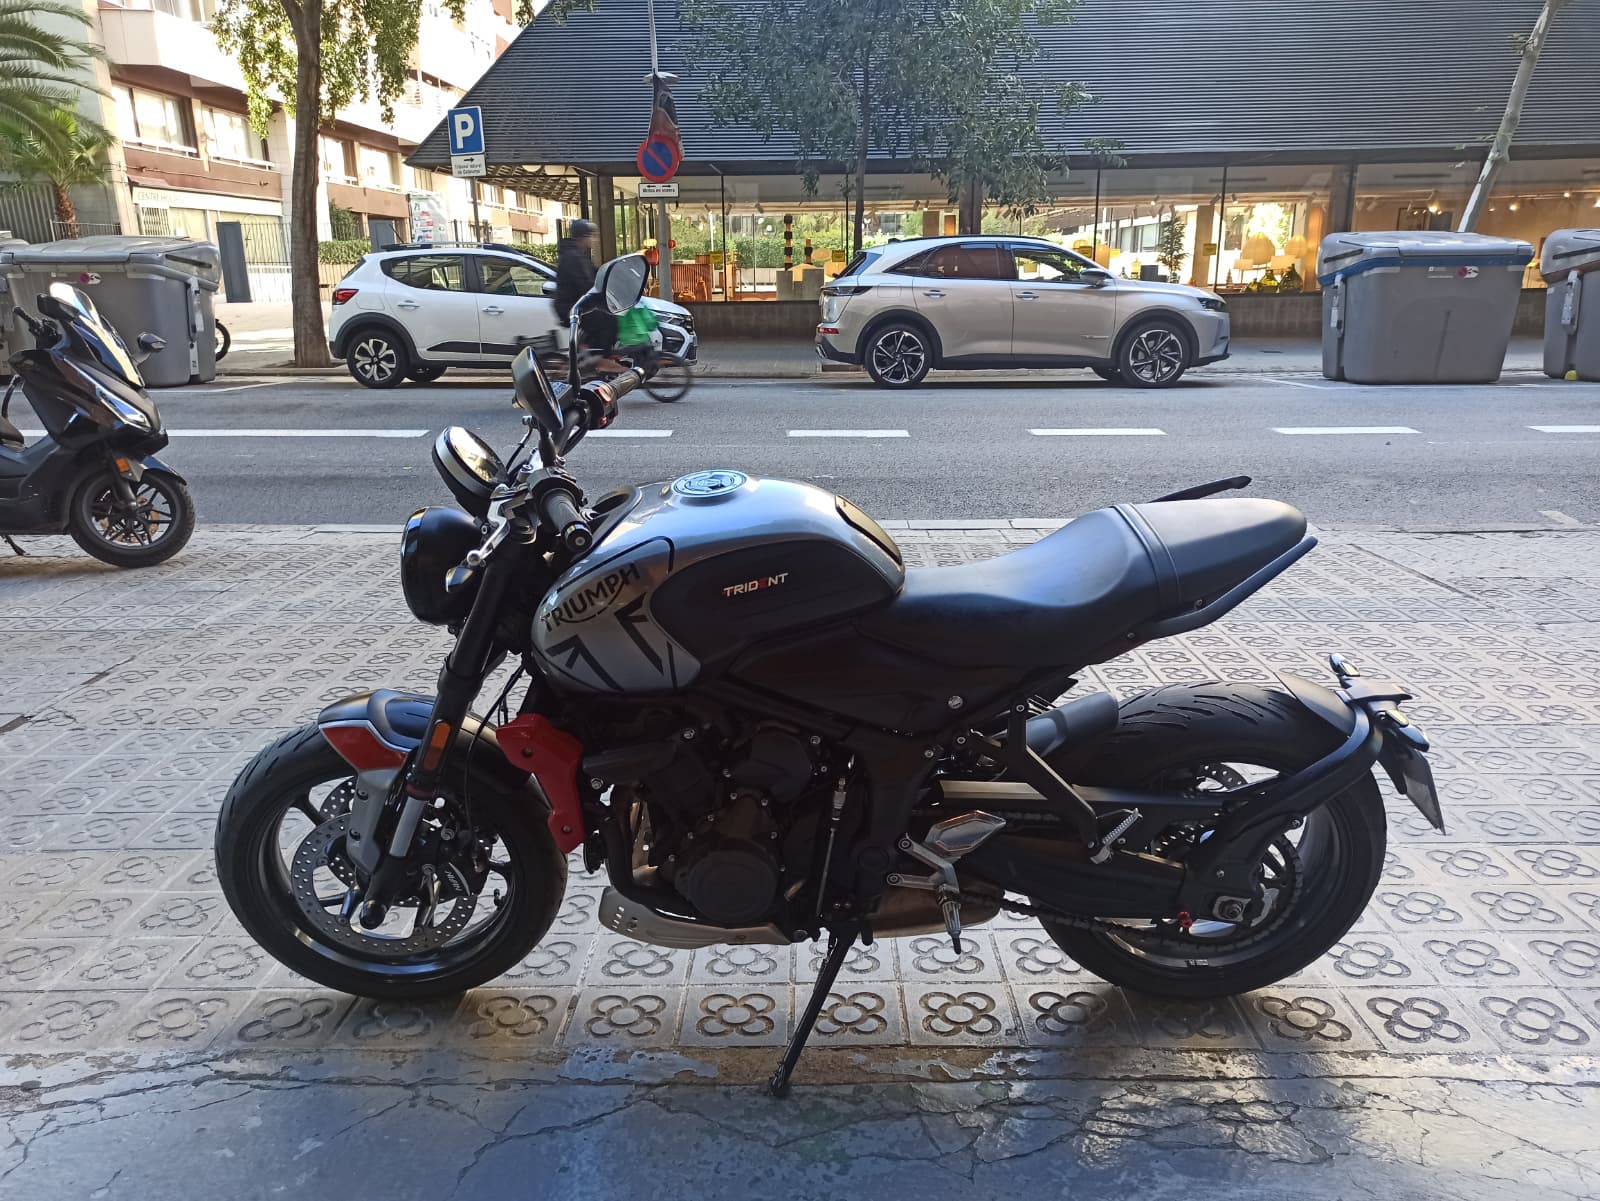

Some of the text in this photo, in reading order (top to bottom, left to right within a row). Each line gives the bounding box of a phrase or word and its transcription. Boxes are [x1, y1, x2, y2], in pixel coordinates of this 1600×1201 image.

[454, 113, 475, 150] P
[540, 562, 640, 633] TRIUMPH
[723, 572, 789, 597] TRIDENT
